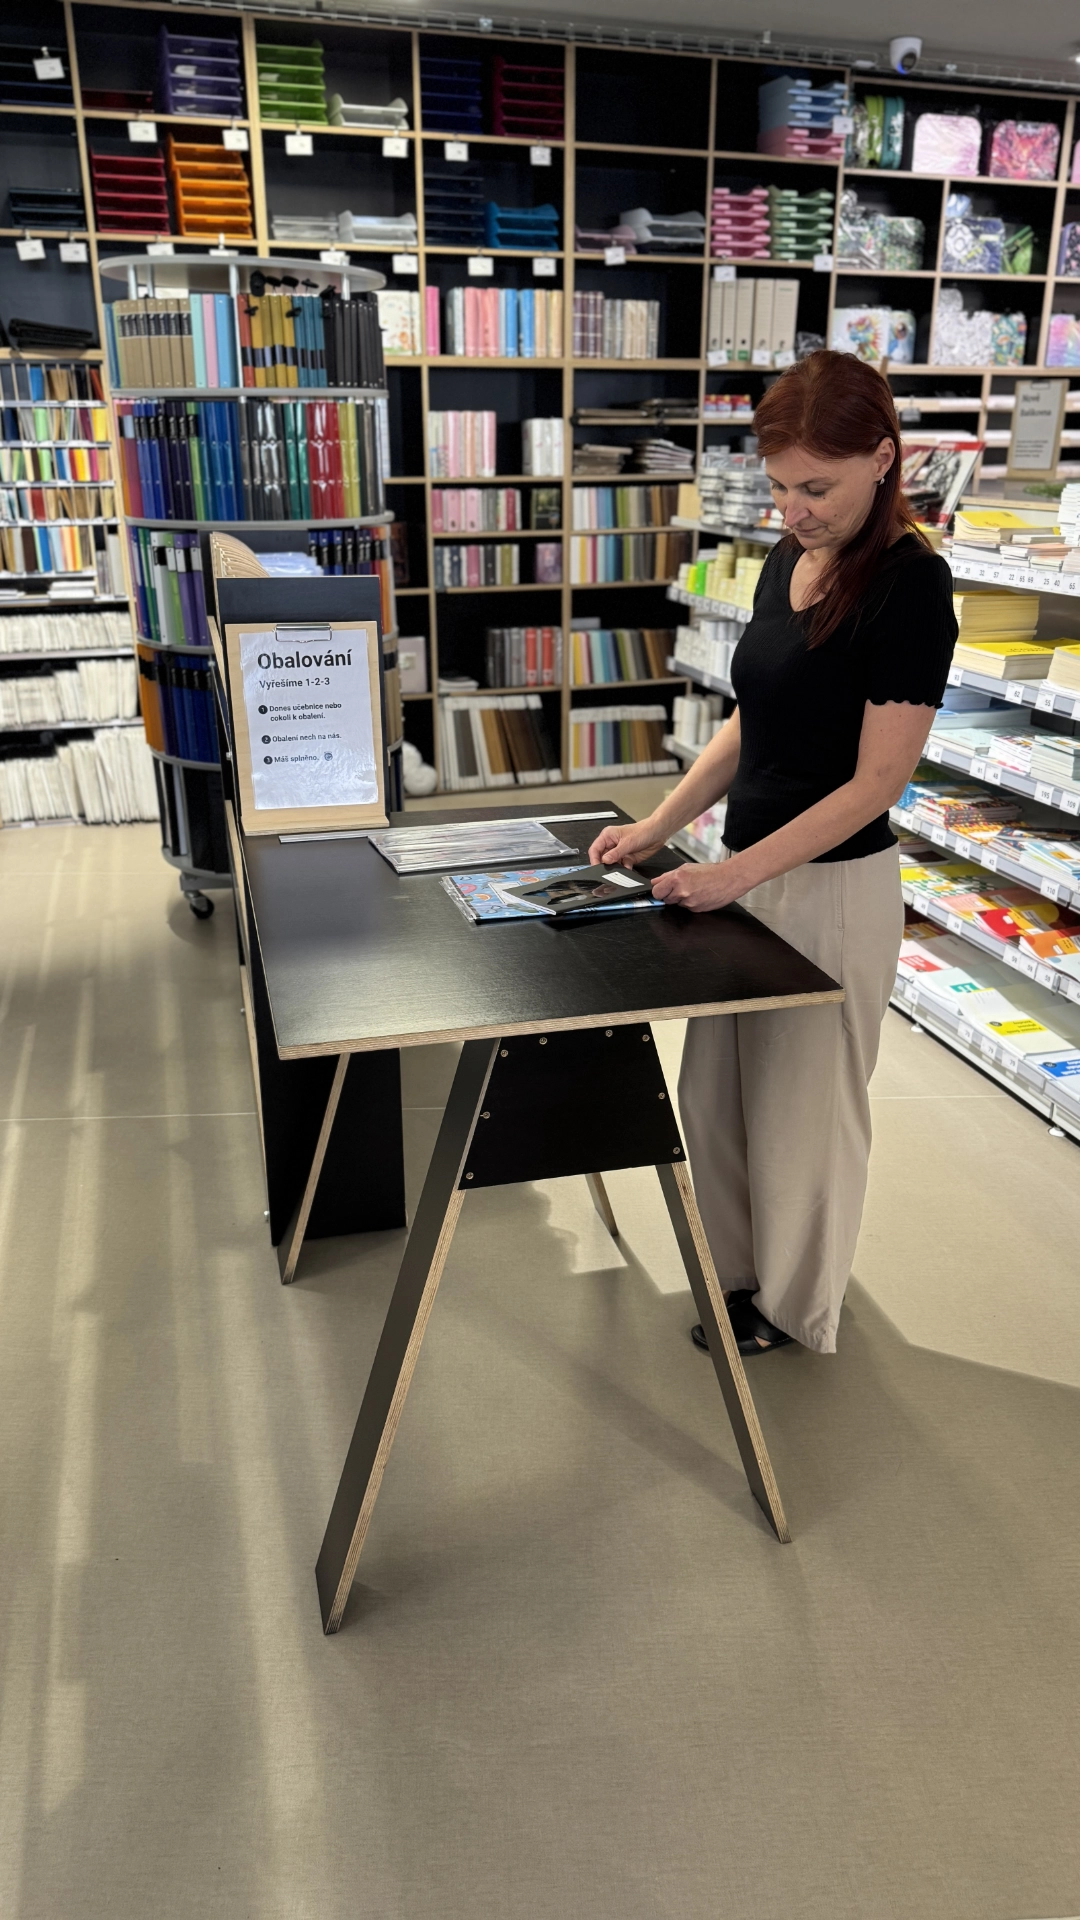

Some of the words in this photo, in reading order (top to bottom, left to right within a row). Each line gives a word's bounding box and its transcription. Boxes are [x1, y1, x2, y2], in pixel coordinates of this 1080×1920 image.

[257, 648, 353, 670] Obalování
[259, 679, 303, 690] Vyřešíme
[305, 677, 330, 687] 1-2-3
[292, 703, 324, 711] učebnice
[298, 712, 326, 720] obalení.
[272, 734, 299, 742] Obalení
[299, 733, 316, 741] nech
[274, 755, 289, 763] Máš
[290, 754, 320, 763] splněno.
[1041, 789, 1050, 799] 195
[1067, 800, 1076, 809] 109
